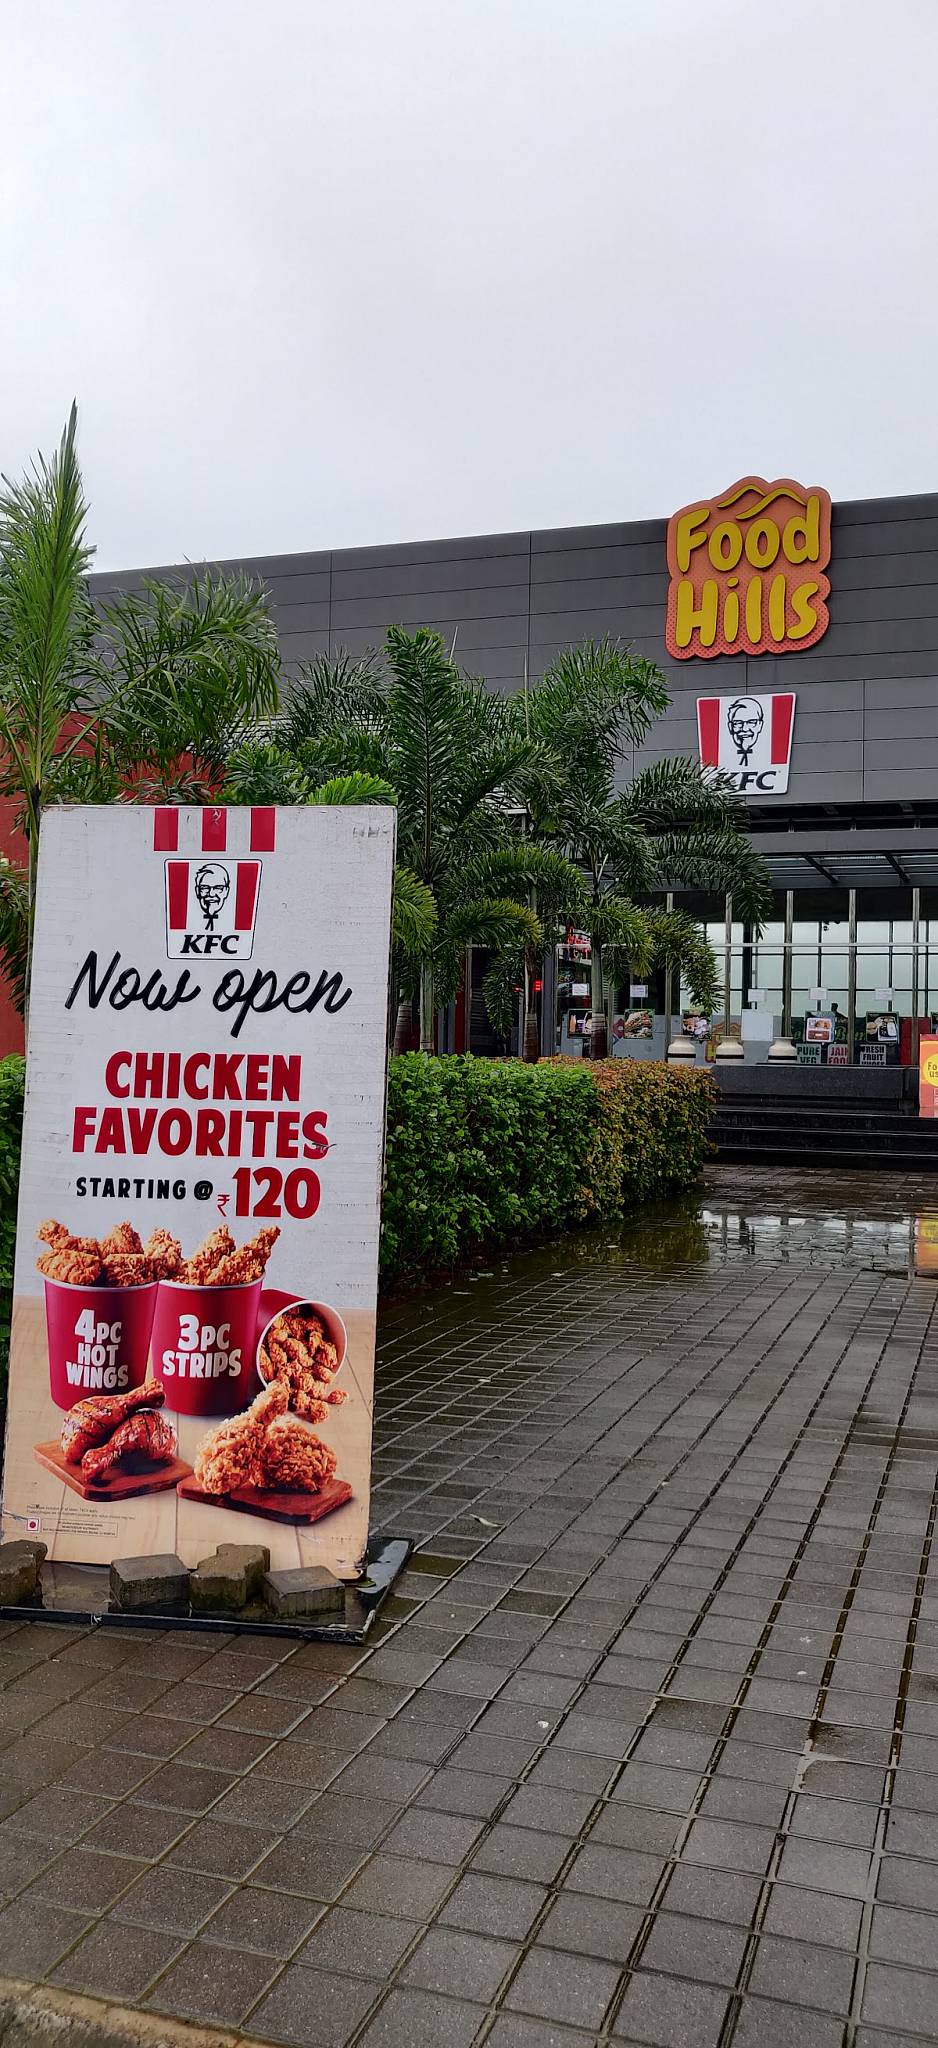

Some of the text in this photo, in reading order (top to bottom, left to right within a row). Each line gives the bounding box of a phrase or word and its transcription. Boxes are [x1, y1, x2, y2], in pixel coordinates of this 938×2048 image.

[676, 495, 820, 573] Food
[675, 573, 819, 648] Hills
[180, 934, 240, 955] KFC
[64, 950, 353, 1039] Now open
[797, 1046, 820, 1056] PURE
[105, 1051, 302, 1101] CHICKEN
[72, 1106, 330, 1160] FAVORITES
[76, 1177, 187, 1201] STARTING
[193, 1180, 214, 1201] @
[74, 1308, 122, 1344] 4PC
[177, 1314, 231, 1351] 3PC
[77, 1342, 119, 1367] HOT
[162, 1348, 242, 1378] STRIPS
[65, 1361, 129, 1389] WINGS
